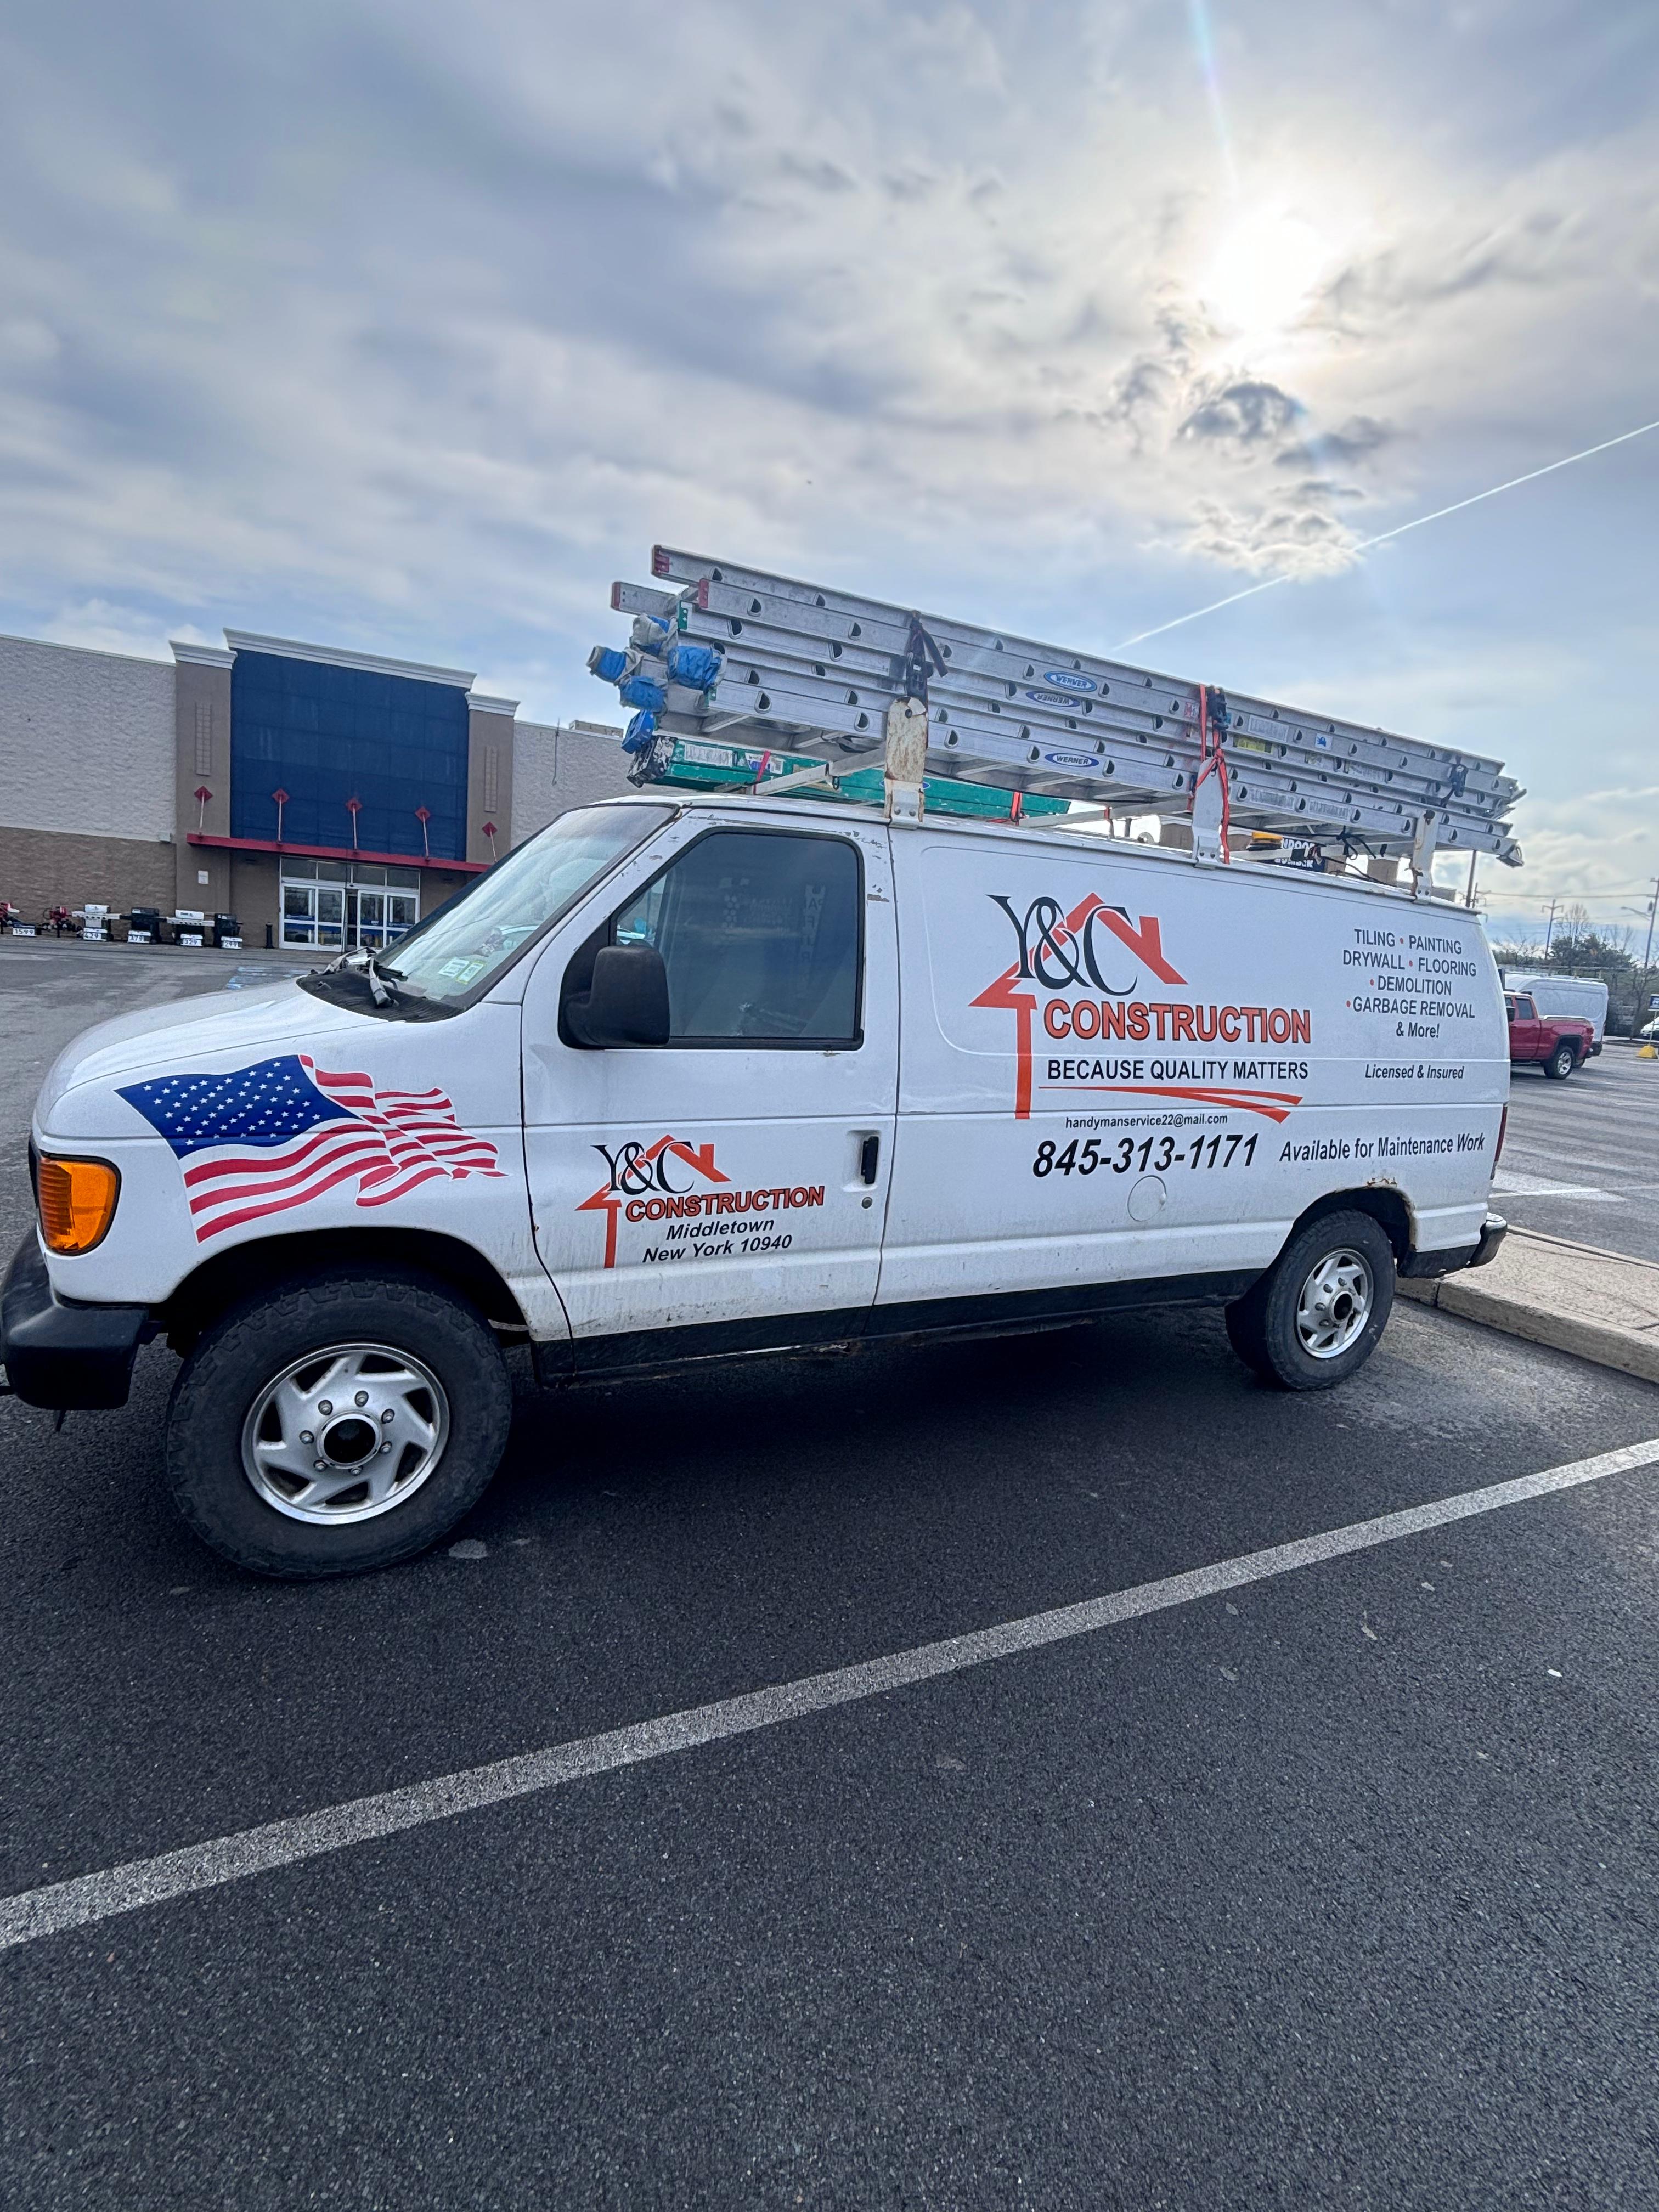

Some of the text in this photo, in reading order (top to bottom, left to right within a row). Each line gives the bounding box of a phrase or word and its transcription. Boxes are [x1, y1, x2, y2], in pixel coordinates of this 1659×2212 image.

[1057, 755, 1088, 764] WERNER
[985, 894, 1138, 996] Y&C
[1353, 928, 1462, 955] TILING PAINTING
[1342, 950, 1477, 977] DRYWALL FLOORING
[1377, 975, 1452, 996] DEMOLITION
[1043, 998, 1312, 1044] CONSTRUCTION
[1353, 996, 1476, 1019] GARBAGE REMOVAL
[1396, 1022, 1440, 1039] & More!
[1047, 1059, 1308, 1080] BECAUSE QUALITY MATTERS
[1365, 1064, 1465, 1079] Licensed & Insured
[1064, 1113, 1228, 1130] handymanservice22@mail.com
[1032, 1133, 1259, 1178] 845-313-1171
[1279, 1132, 1486, 1162] Available for Maintenance Work
[590, 1141, 695, 1195] Y&C
[625, 1185, 825, 1222] CONSTRUCTION
[665, 1219, 775, 1241] Middletown
[641, 1234, 793, 1263] New York 10940
